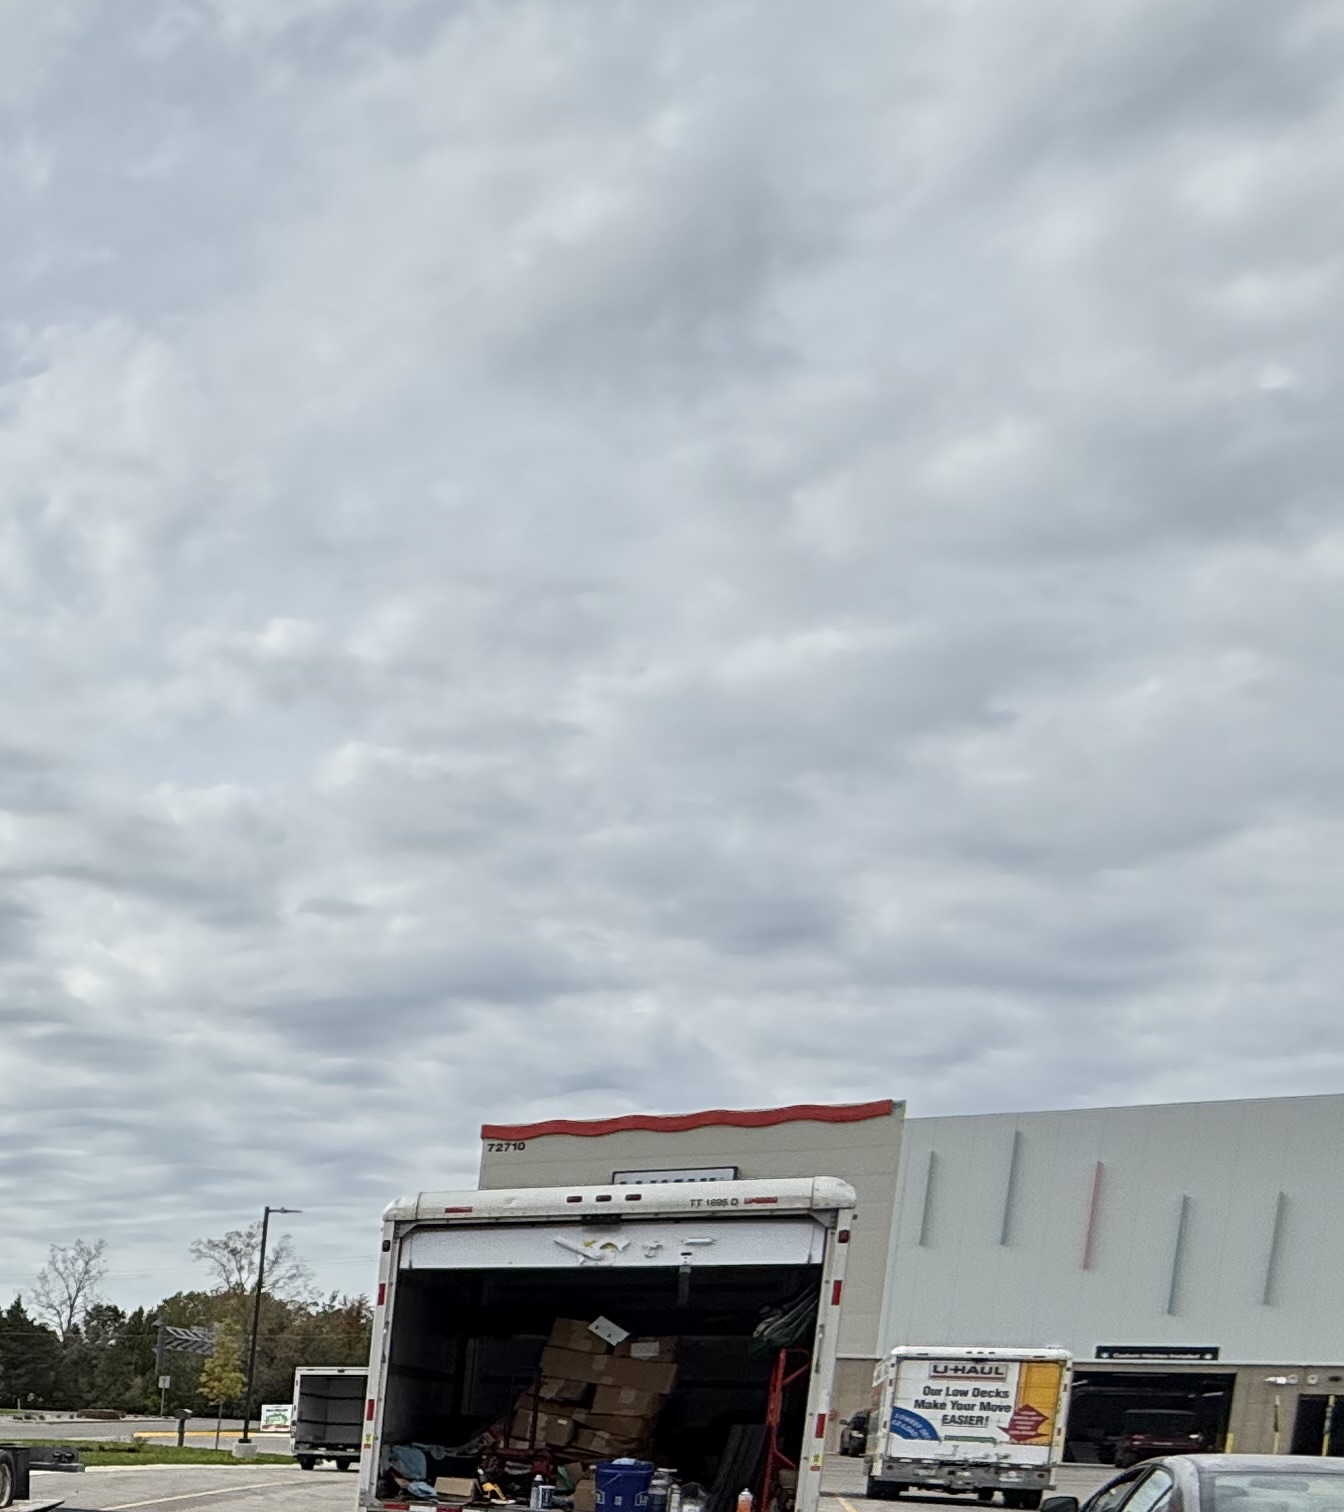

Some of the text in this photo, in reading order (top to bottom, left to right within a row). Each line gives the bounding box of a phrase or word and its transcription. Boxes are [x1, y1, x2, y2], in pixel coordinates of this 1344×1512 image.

[487, 1142, 526, 1152] 72710
[932, 1364, 1004, 1375] U-HAUL
[923, 1385, 1010, 1399] Our Low Decks
[914, 1400, 1012, 1412] Make Your Move
[941, 1414, 989, 1426] EASIER!
